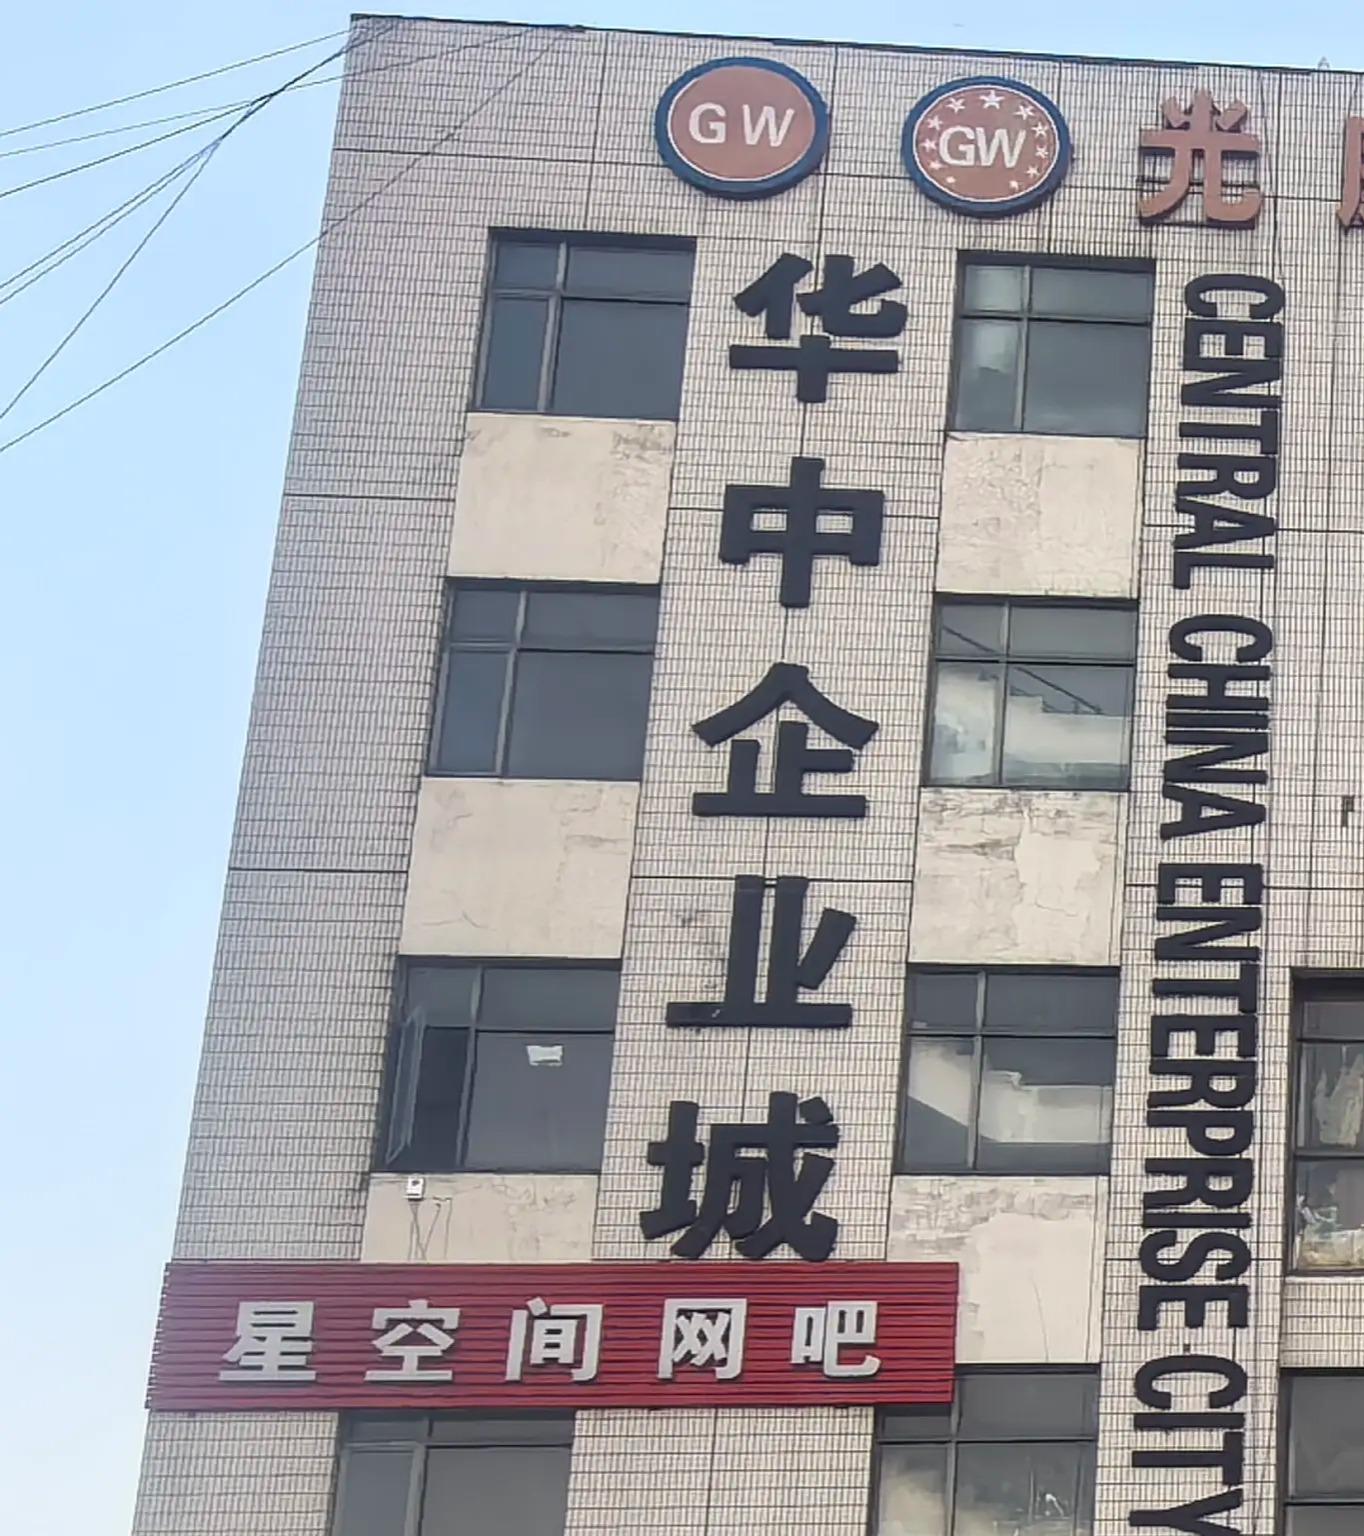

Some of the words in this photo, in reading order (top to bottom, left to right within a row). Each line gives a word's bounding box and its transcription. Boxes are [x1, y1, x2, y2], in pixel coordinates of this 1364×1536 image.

[688, 102, 796, 148] GW
[938, 125, 1027, 170] GW
[1172, 273, 1286, 592] CENTRAL
[639, 253, 908, 1263] 华中企业城
[1160, 613, 1274, 841] CHINA
[1138, 863, 1264, 1331] ENTERPRISE
[218, 1296, 882, 1384] 星空间网吧
